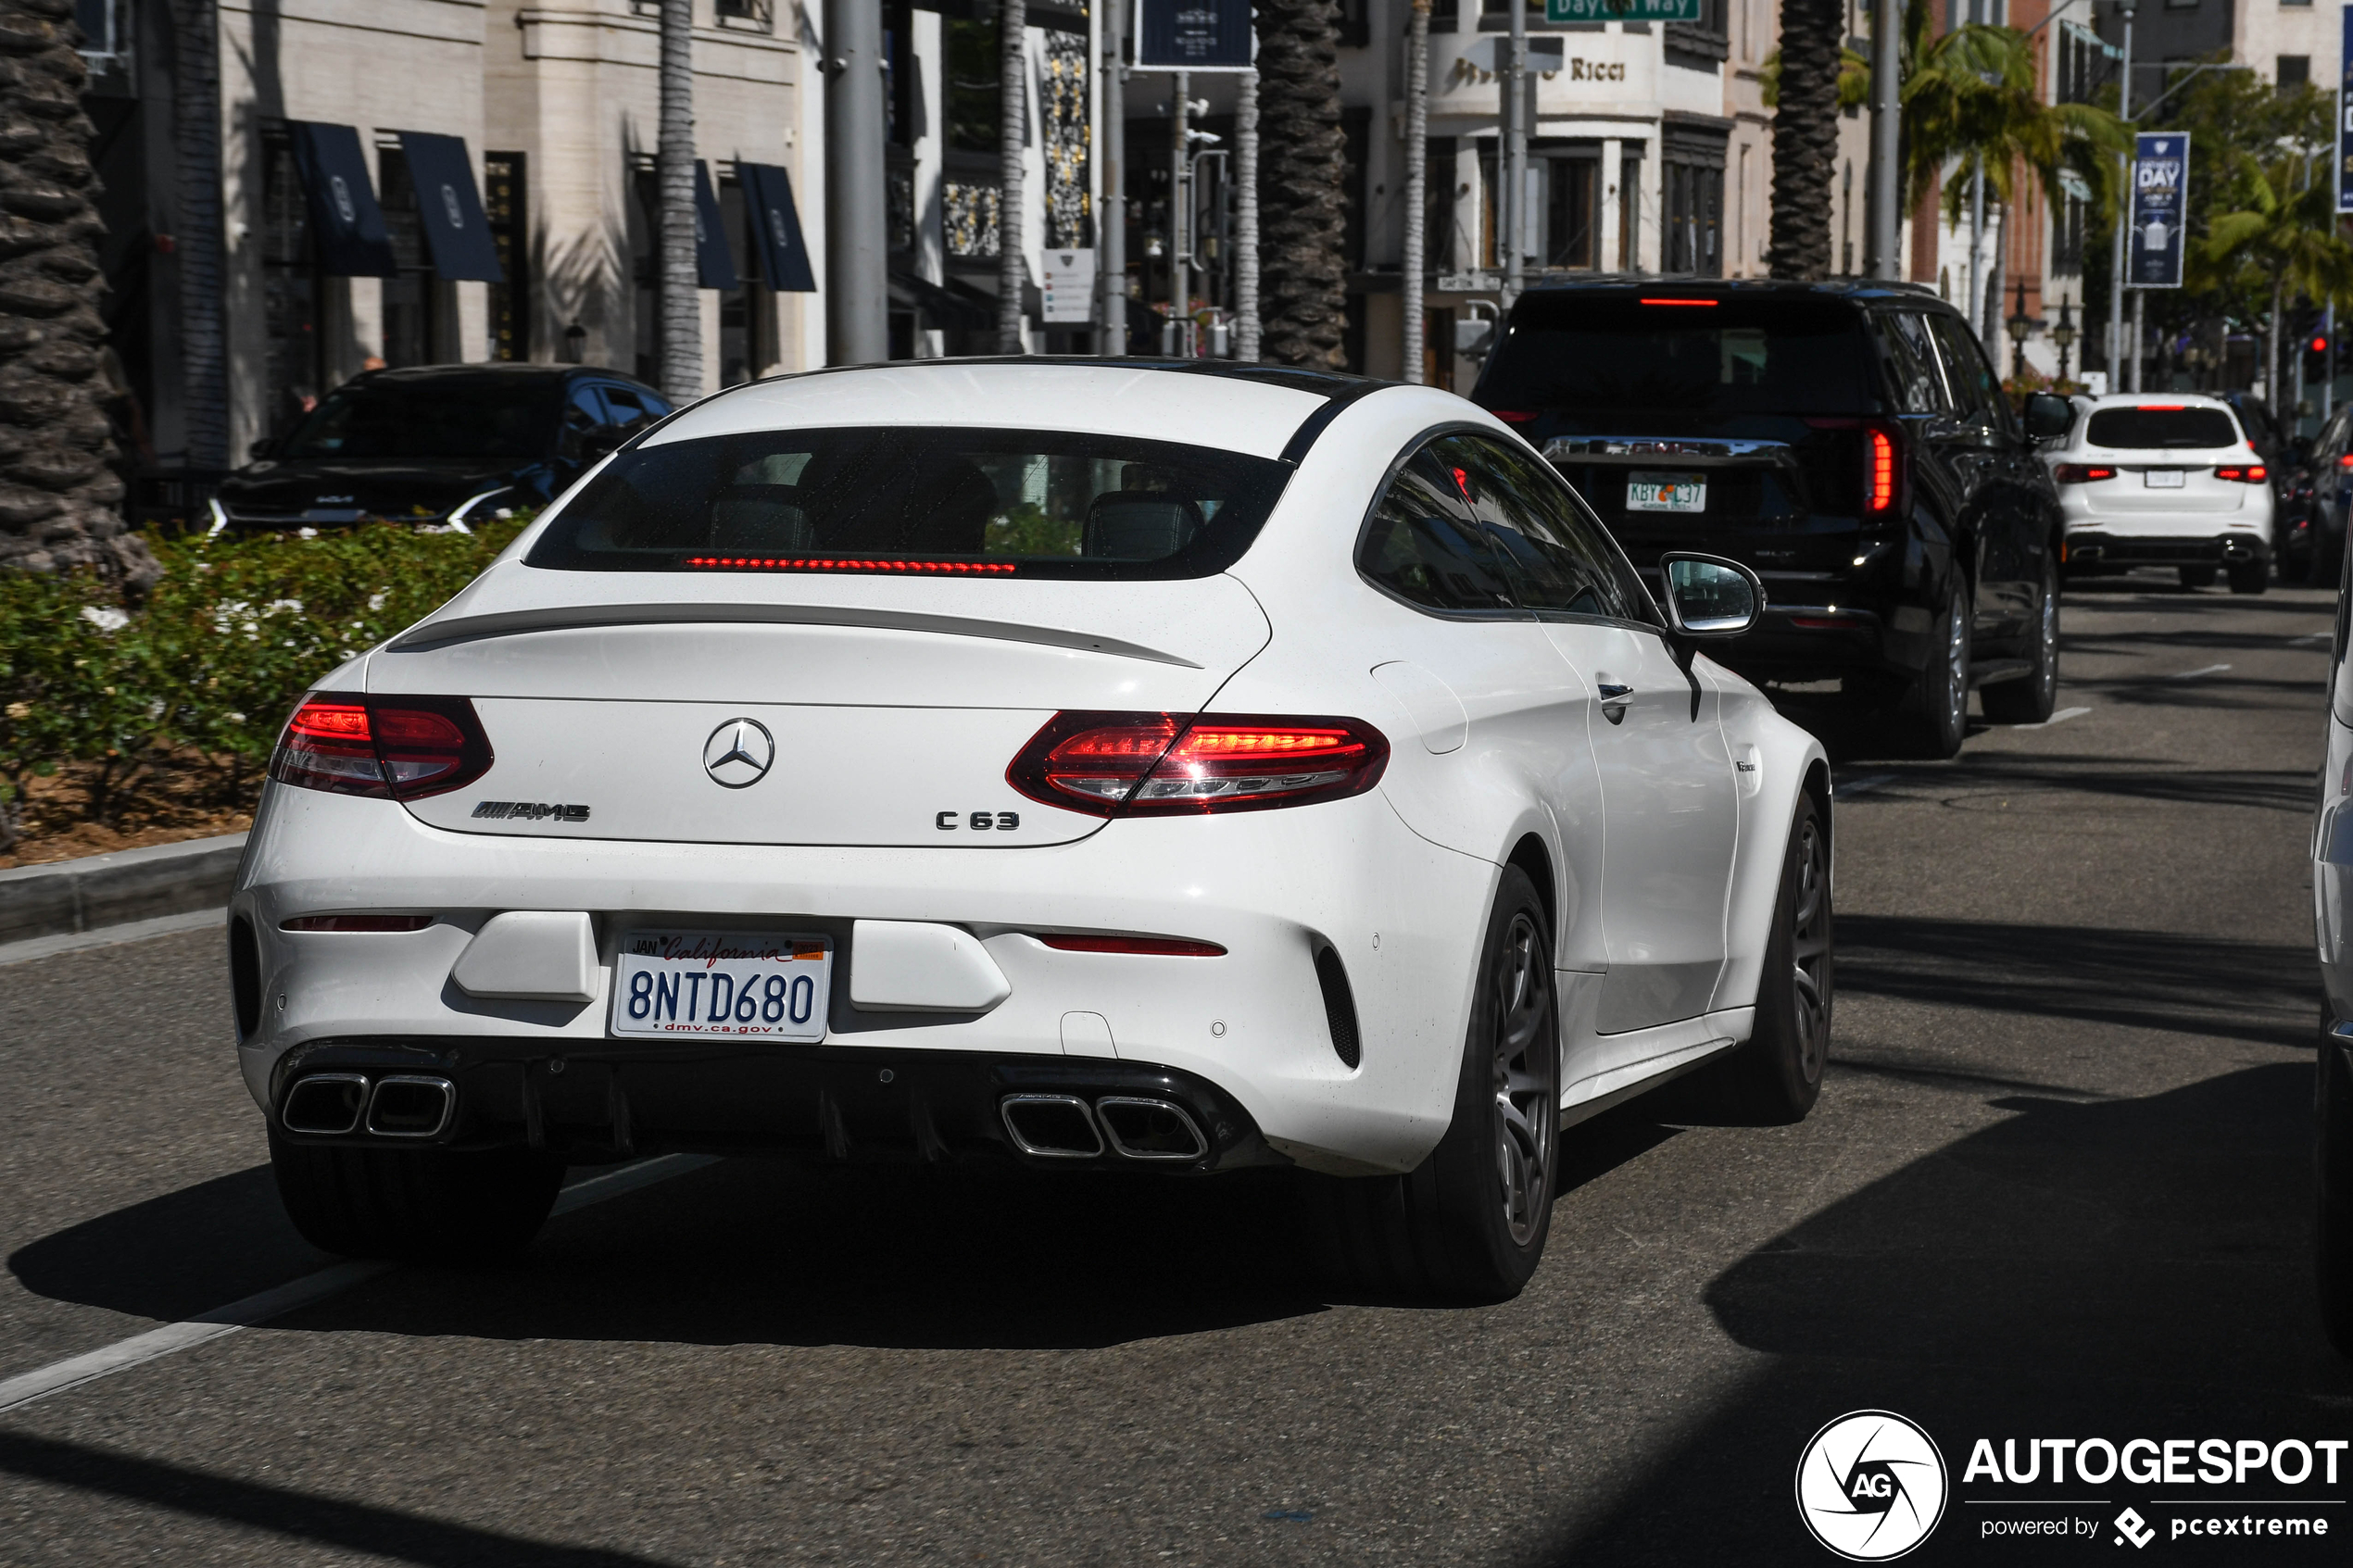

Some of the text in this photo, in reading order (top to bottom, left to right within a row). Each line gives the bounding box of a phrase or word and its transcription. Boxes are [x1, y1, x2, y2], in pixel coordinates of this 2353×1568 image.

[1645, 0, 1690, 16] Way
[2138, 166, 2181, 188] DAY
[936, 811, 1020, 831] C 63
[632, 939, 658, 955] JAN
[663, 936, 794, 969] California
[627, 970, 814, 1024] 8NTD680
[664, 1022, 773, 1035] dmv.ca.gov
